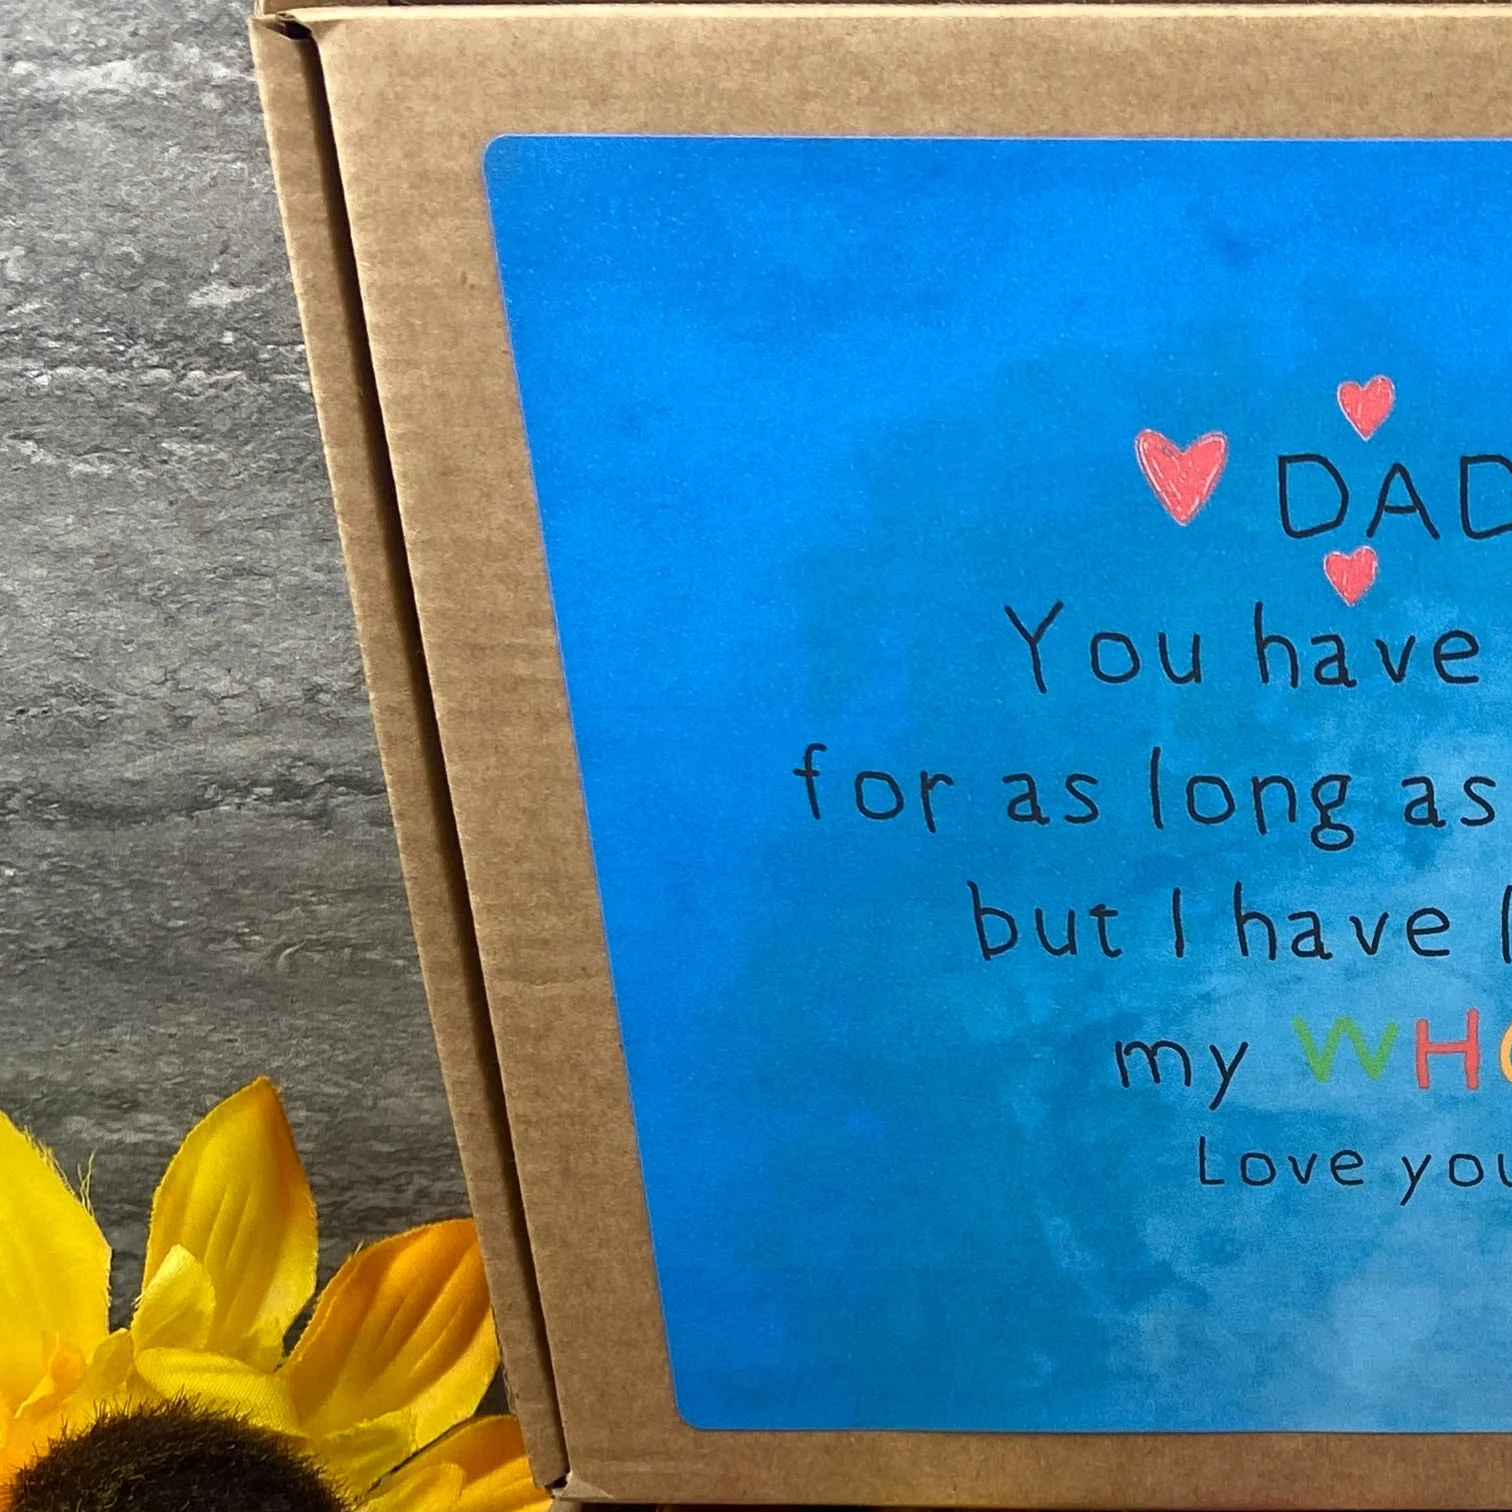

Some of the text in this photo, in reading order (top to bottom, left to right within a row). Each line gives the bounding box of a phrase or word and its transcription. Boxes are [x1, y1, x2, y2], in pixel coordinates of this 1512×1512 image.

[1005, 602, 1201, 693] You
[1254, 602, 1479, 688] have
[793, 743, 954, 833] for
[1002, 773, 1098, 826] as
[1150, 746, 1355, 852] long
[1402, 776, 1496, 828] as
[968, 880, 1122, 961] but
[1172, 887, 1185, 958] I
[1233, 880, 1450, 961] have
[1114, 1040, 1249, 1111] my
[1198, 1135, 1364, 1187] Love
